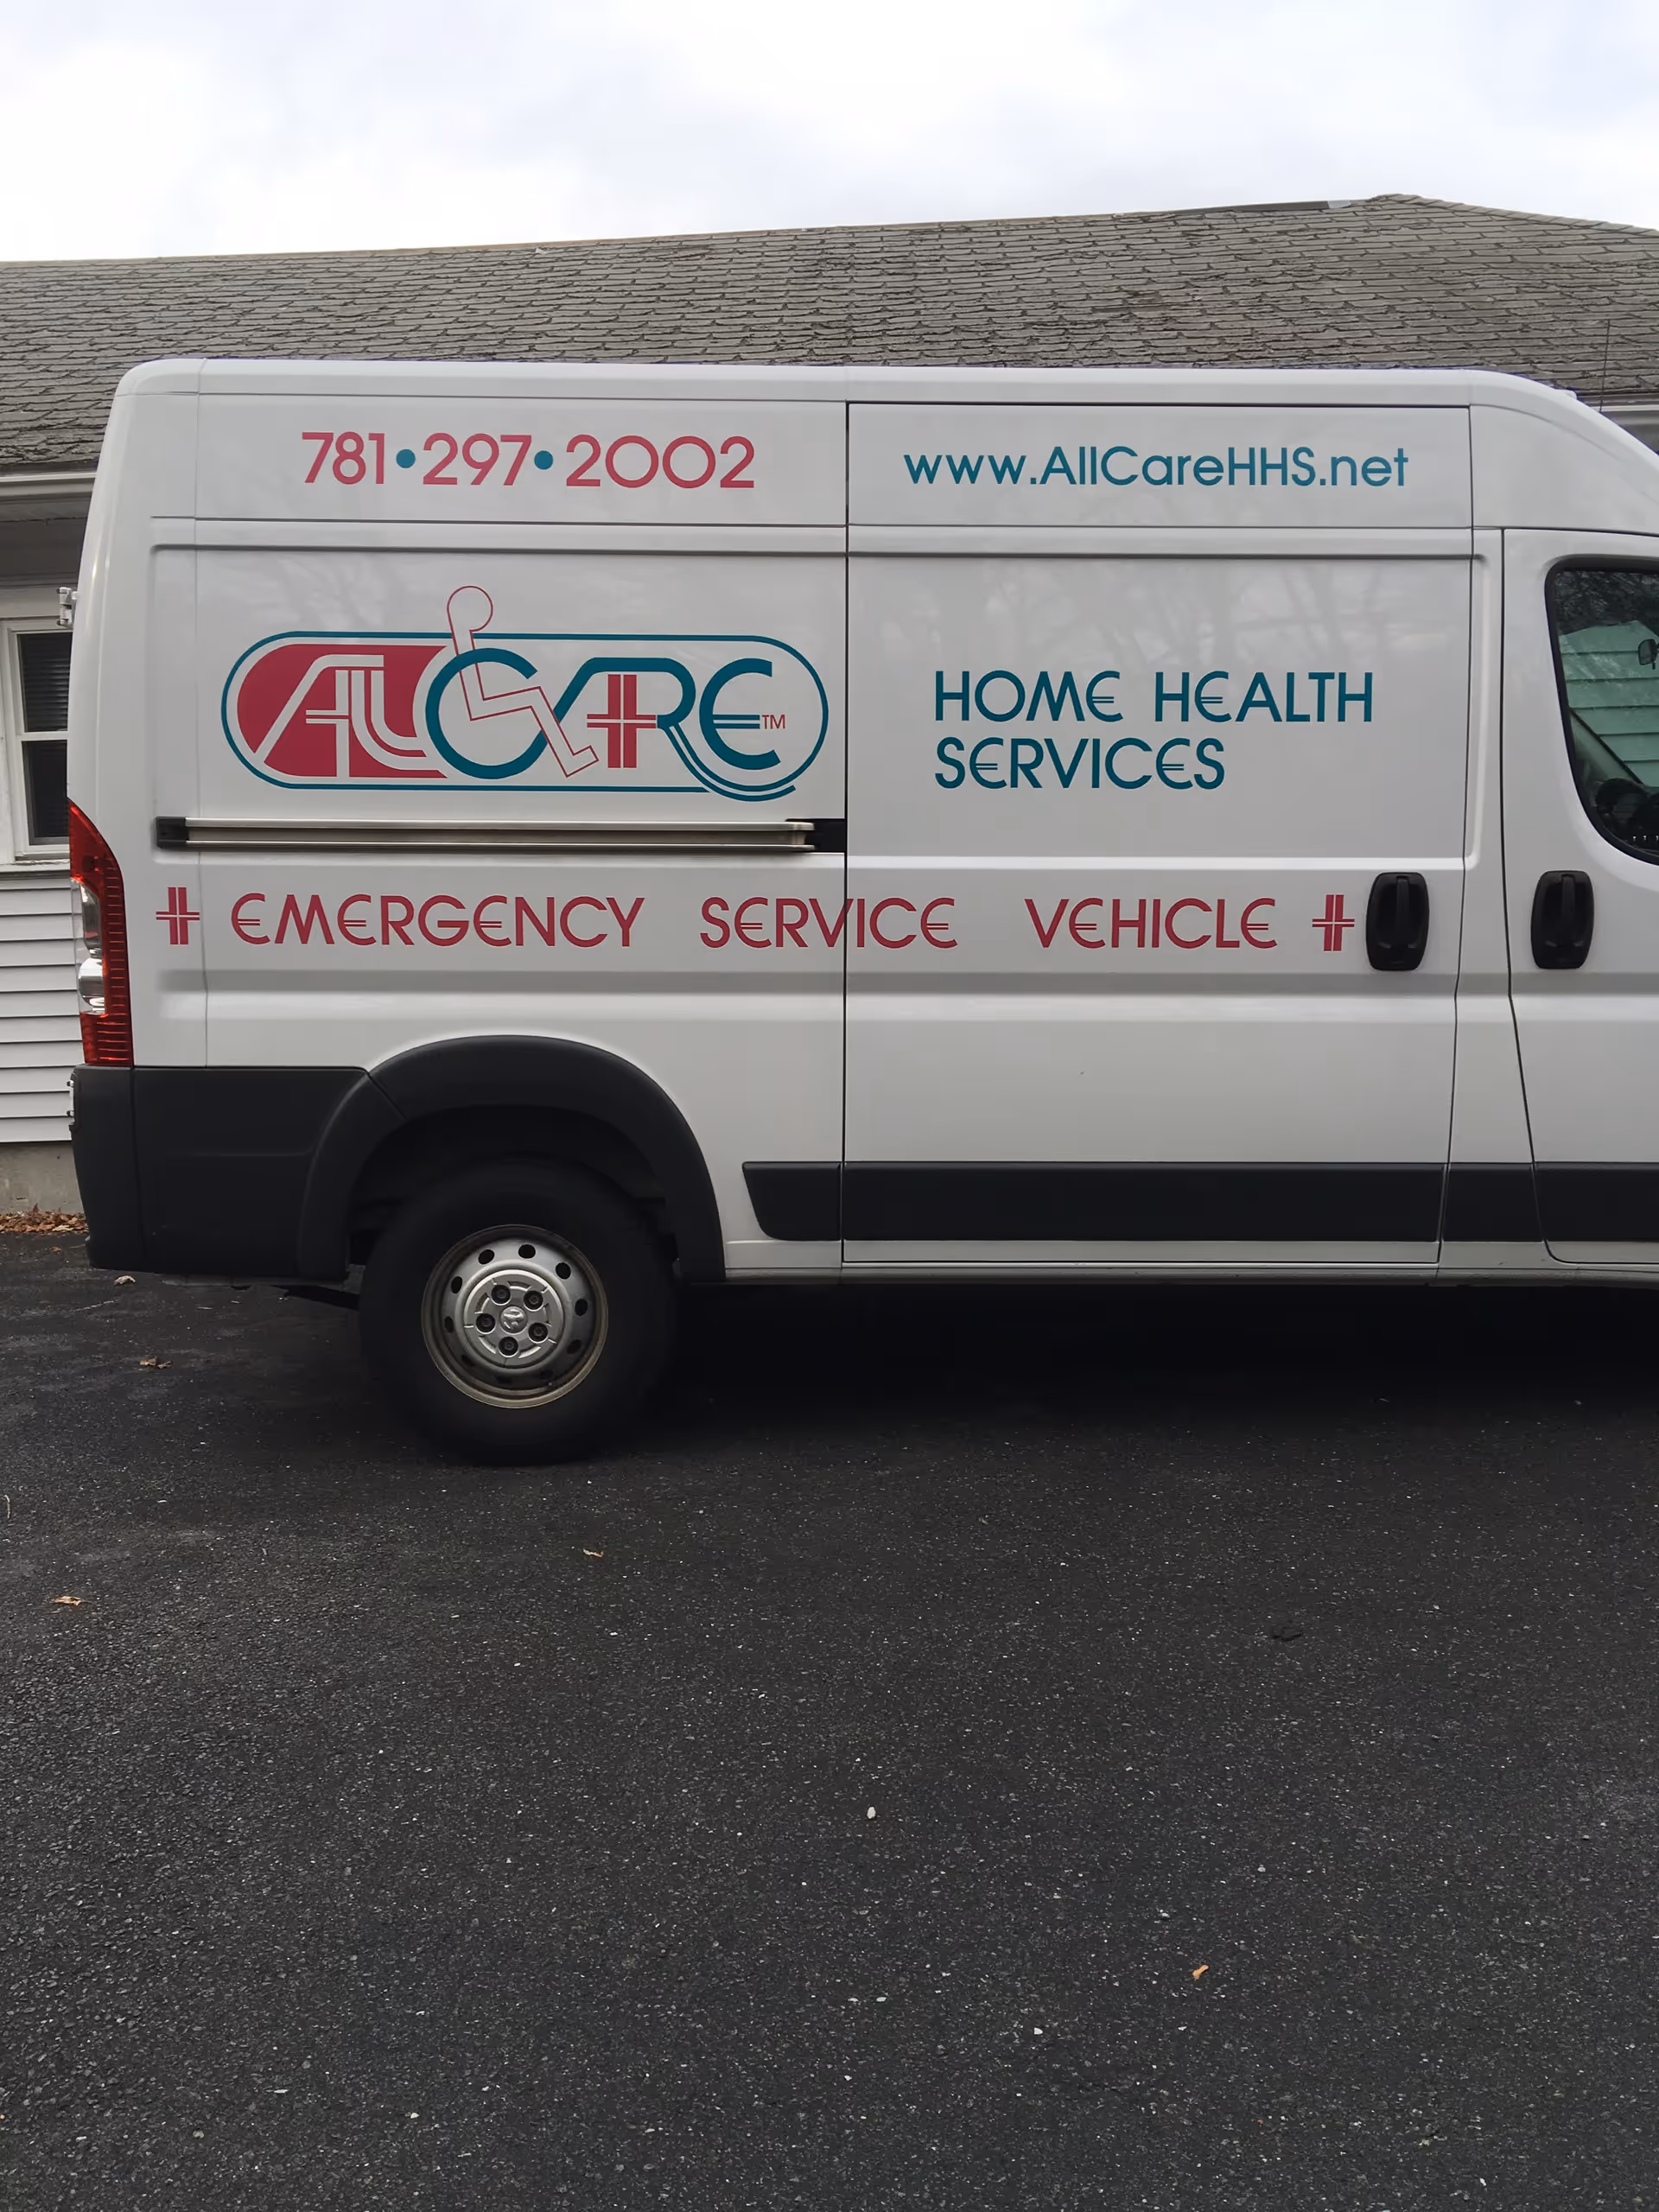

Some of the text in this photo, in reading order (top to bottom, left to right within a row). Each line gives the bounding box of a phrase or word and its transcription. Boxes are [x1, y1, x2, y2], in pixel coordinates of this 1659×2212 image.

[903, 445, 1409, 487] www.AllCareHHS.net
[934, 670, 1373, 723] HOME HEALTH
[934, 736, 1225, 790] SERVICES
[231, 892, 1278, 950] EMERGENCY SERVICE VEHICLE
